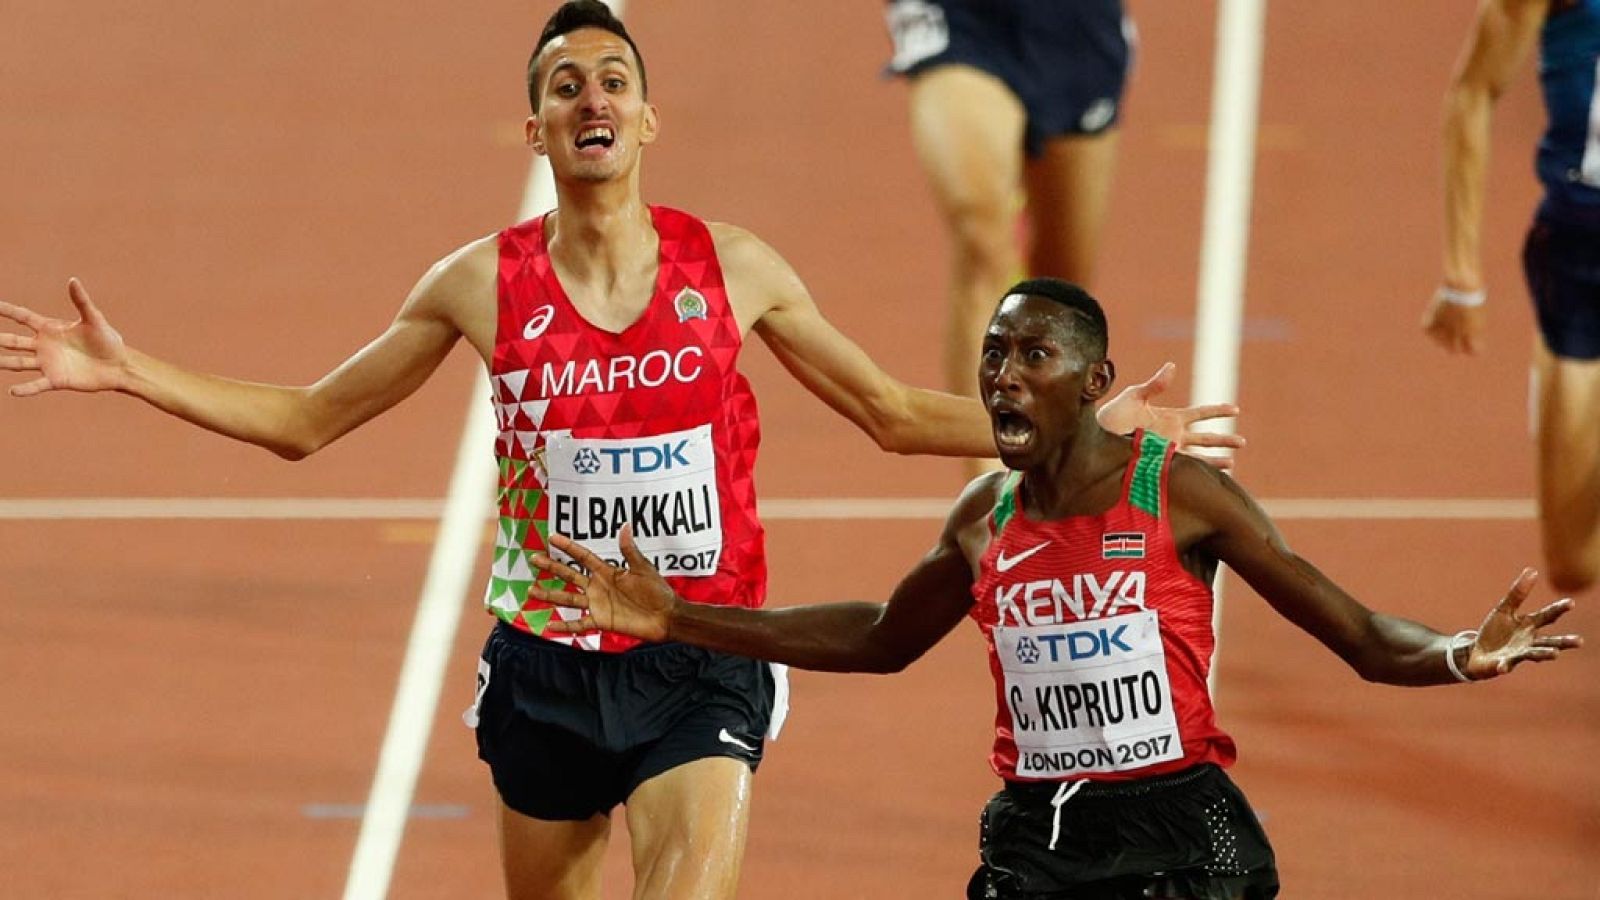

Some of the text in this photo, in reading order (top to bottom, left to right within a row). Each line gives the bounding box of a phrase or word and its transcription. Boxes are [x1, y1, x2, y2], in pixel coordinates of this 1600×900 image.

[540, 346, 703, 398] MAROC
[600, 439, 690, 475] TDK
[555, 484, 713, 541] ELBAKKALI
[664, 550, 716, 571] 2017
[995, 571, 1147, 627] KENYA
[1037, 624, 1134, 662] TDK
[1035, 669, 1162, 732] KIPRUTO
[1023, 734, 1172, 772] LONDON 2017
